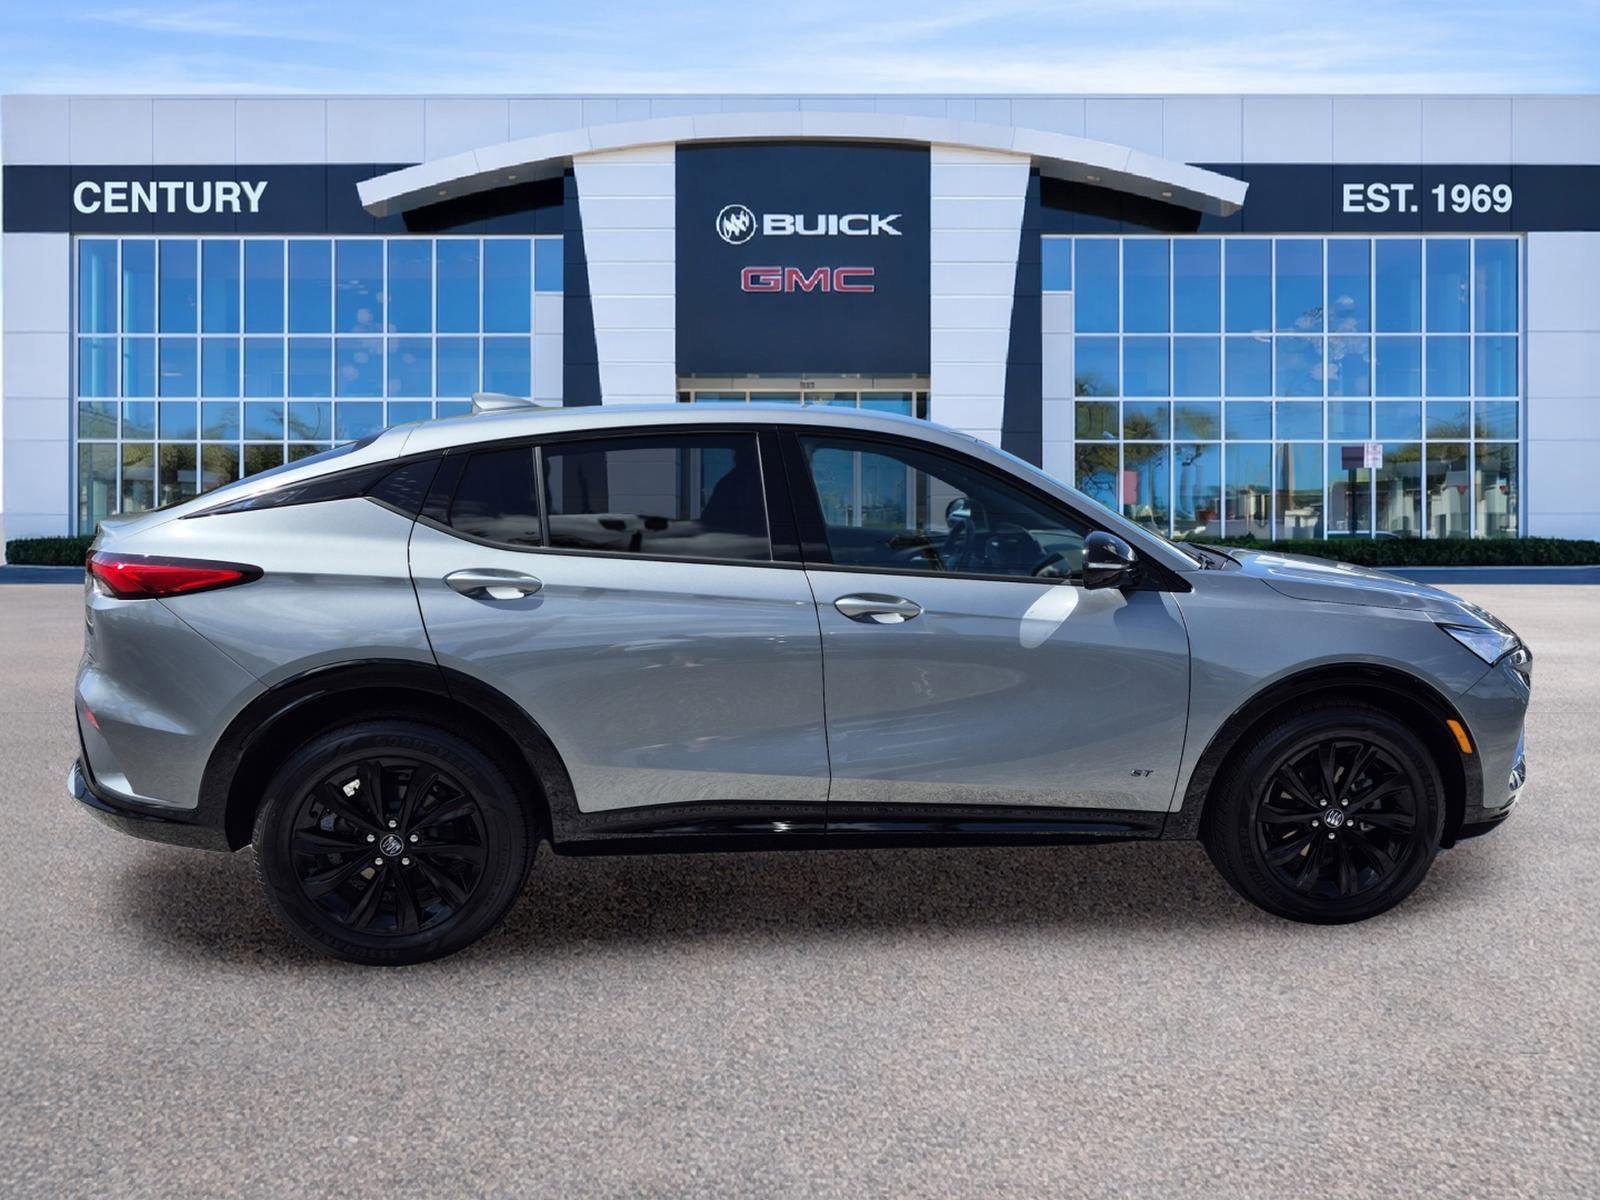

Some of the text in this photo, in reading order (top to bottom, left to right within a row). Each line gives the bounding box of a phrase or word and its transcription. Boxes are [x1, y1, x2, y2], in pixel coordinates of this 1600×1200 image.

[73, 180, 268, 214] CENTURY
[1342, 182, 1513, 213] EST. 1969
[762, 213, 903, 236] BUICK
[741, 266, 875, 293] GMC
